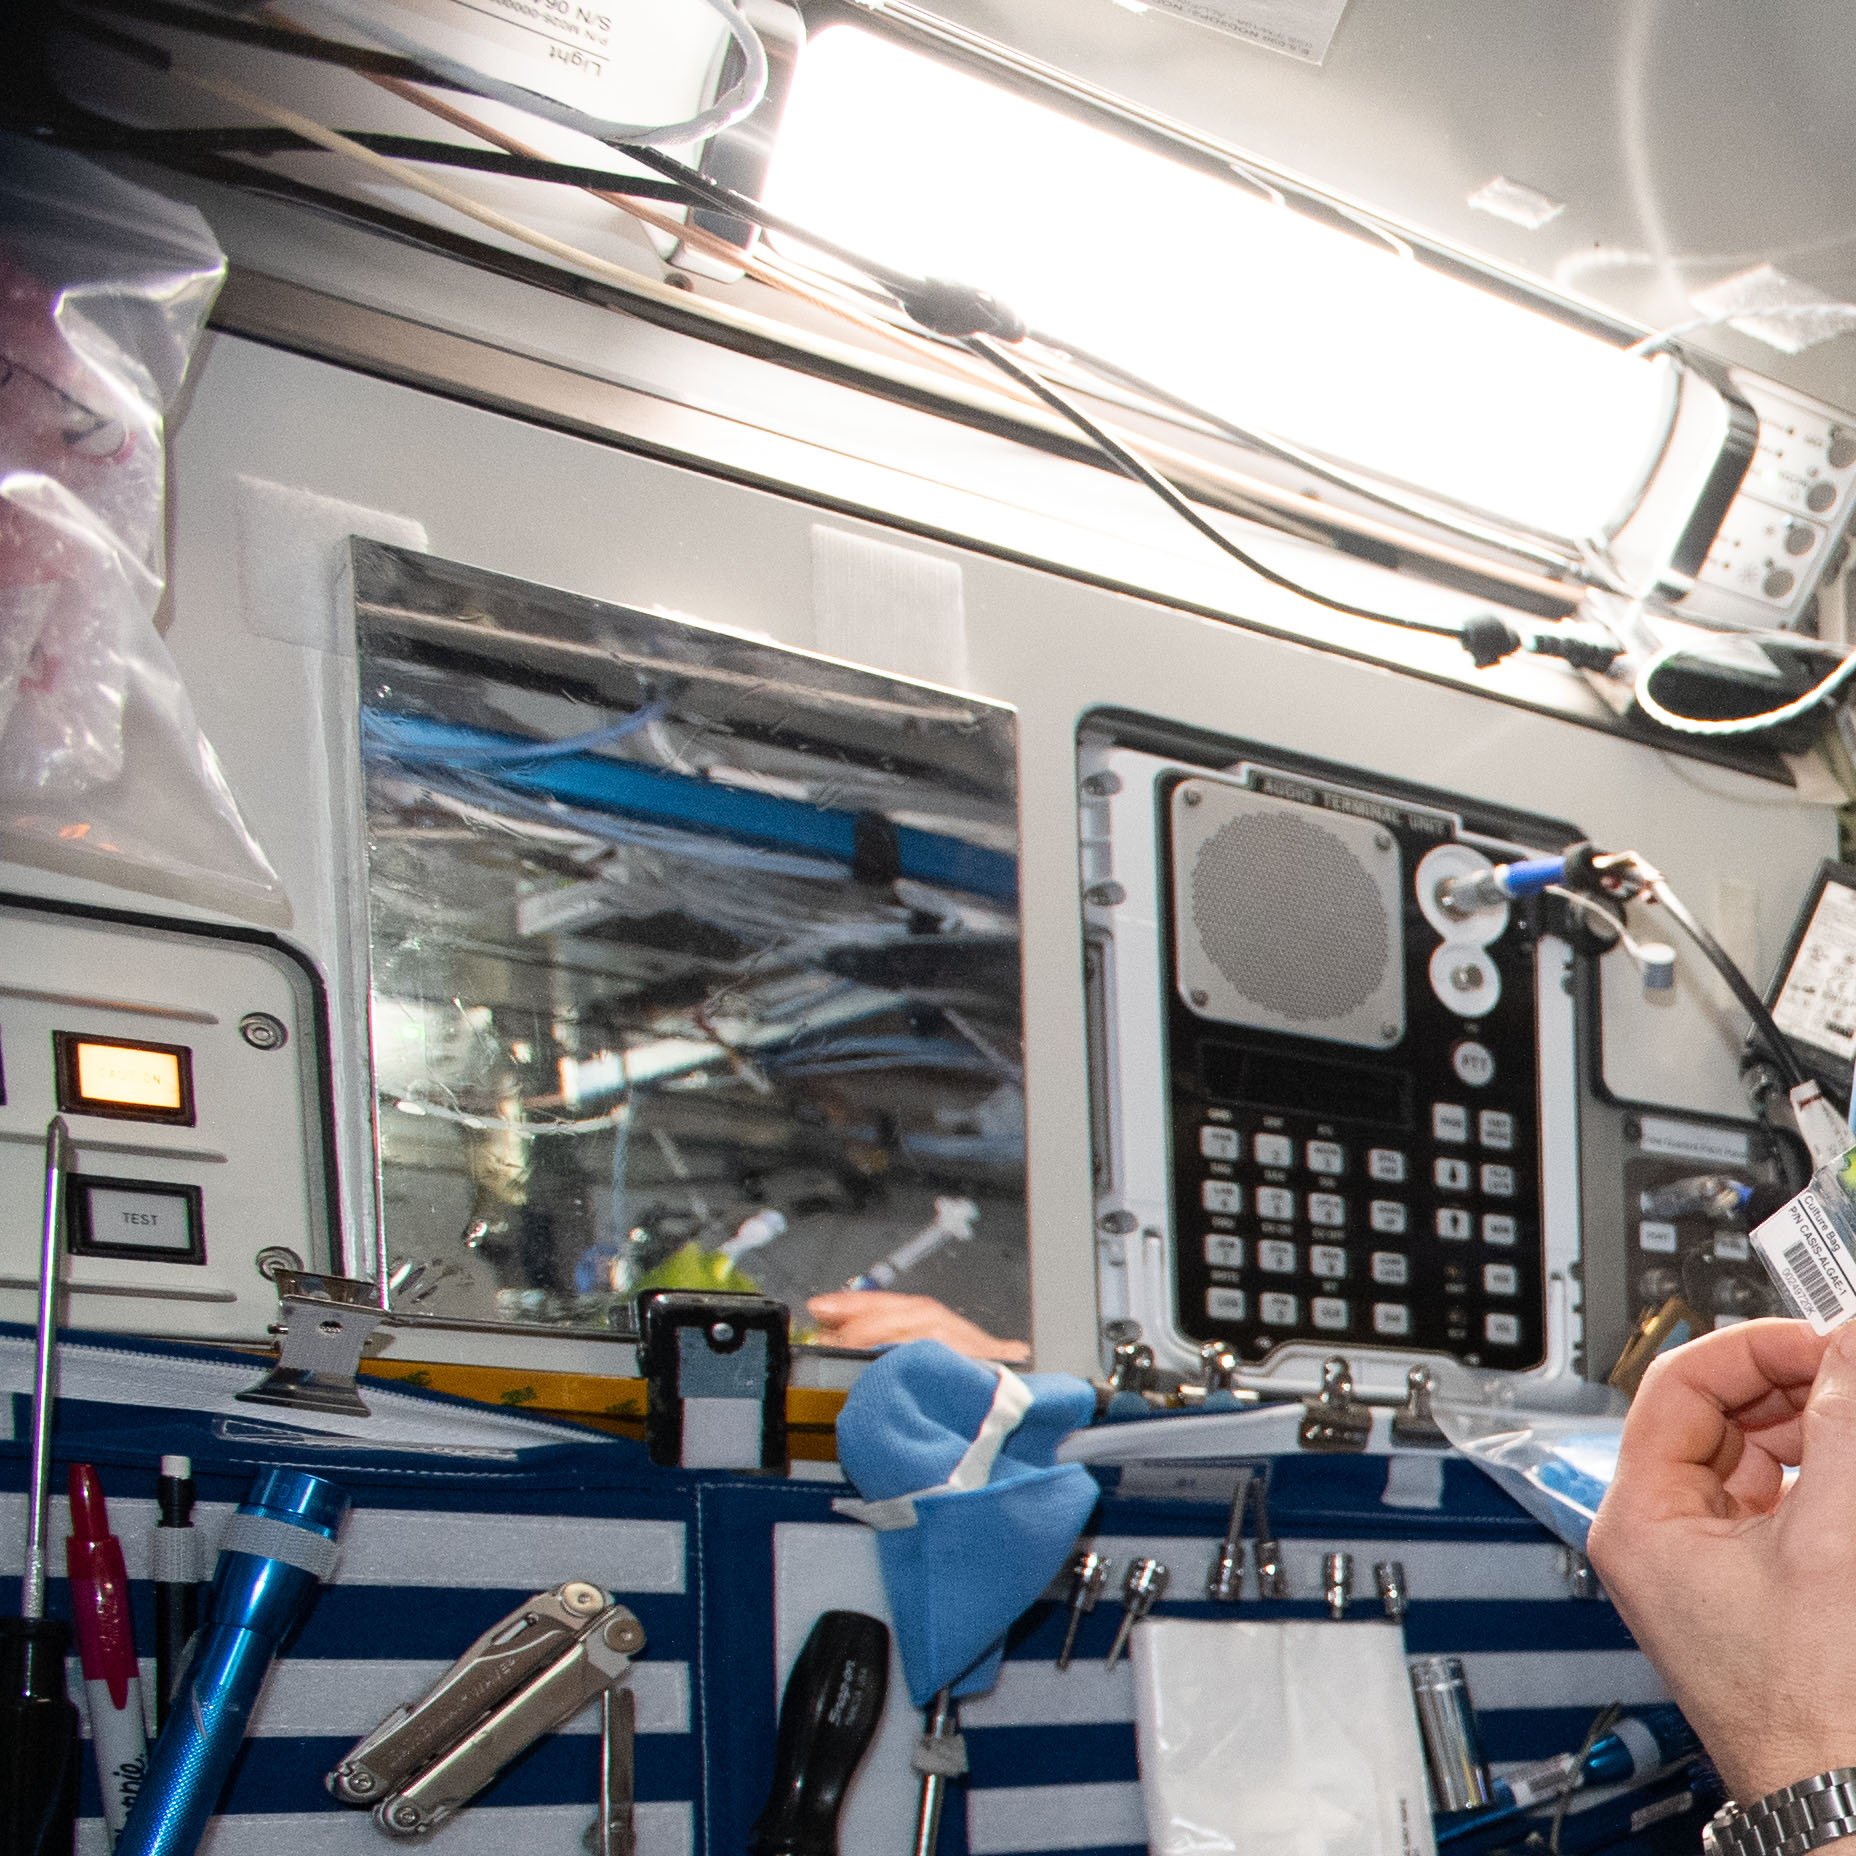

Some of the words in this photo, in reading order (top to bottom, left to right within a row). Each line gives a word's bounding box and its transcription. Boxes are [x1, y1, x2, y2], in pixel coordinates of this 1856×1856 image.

[549, 44, 601, 77] Light
[121, 1211, 159, 1227] TEST
[1802, 1194, 1829, 1233] Culture
[1826, 1231, 1842, 1254] Bag
[1788, 1205, 1804, 1225] P/N
[1799, 1221, 1848, 1297] CASIS-ALGAE-1
